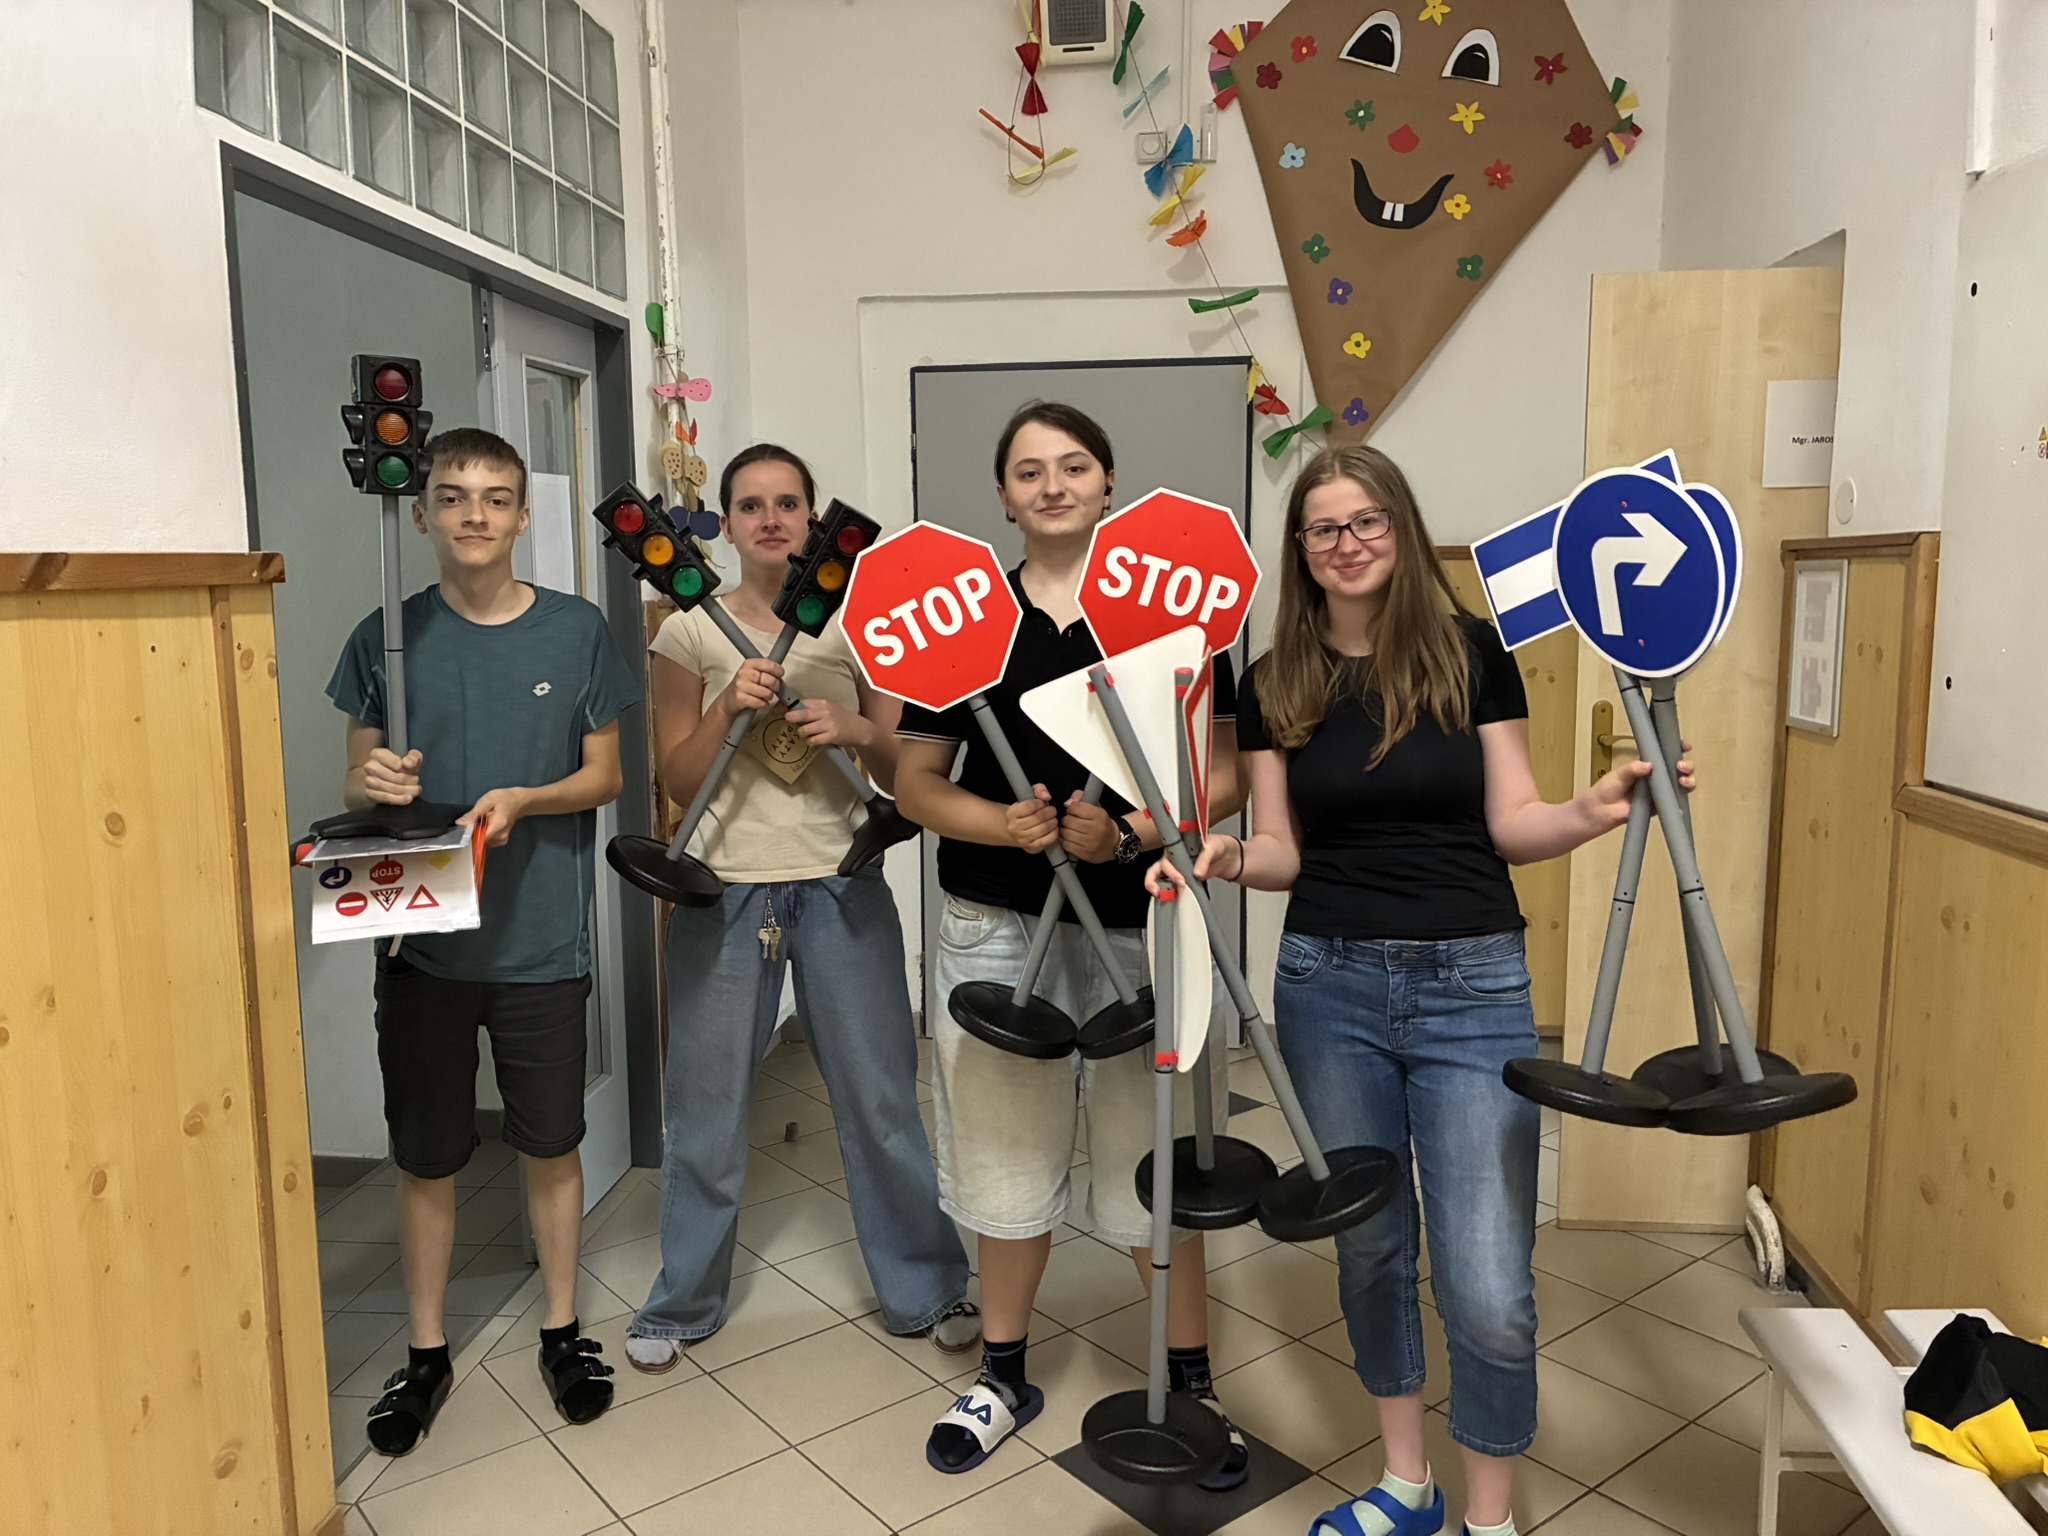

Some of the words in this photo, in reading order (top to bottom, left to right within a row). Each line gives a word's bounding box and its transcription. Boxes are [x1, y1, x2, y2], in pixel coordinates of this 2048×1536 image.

[1792, 436, 1810, 445] Mgr.
[1097, 546, 1240, 624] STOP
[863, 567, 992, 667] STOP
[771, 725, 793, 751] PATY
[372, 866, 401, 878] STOP
